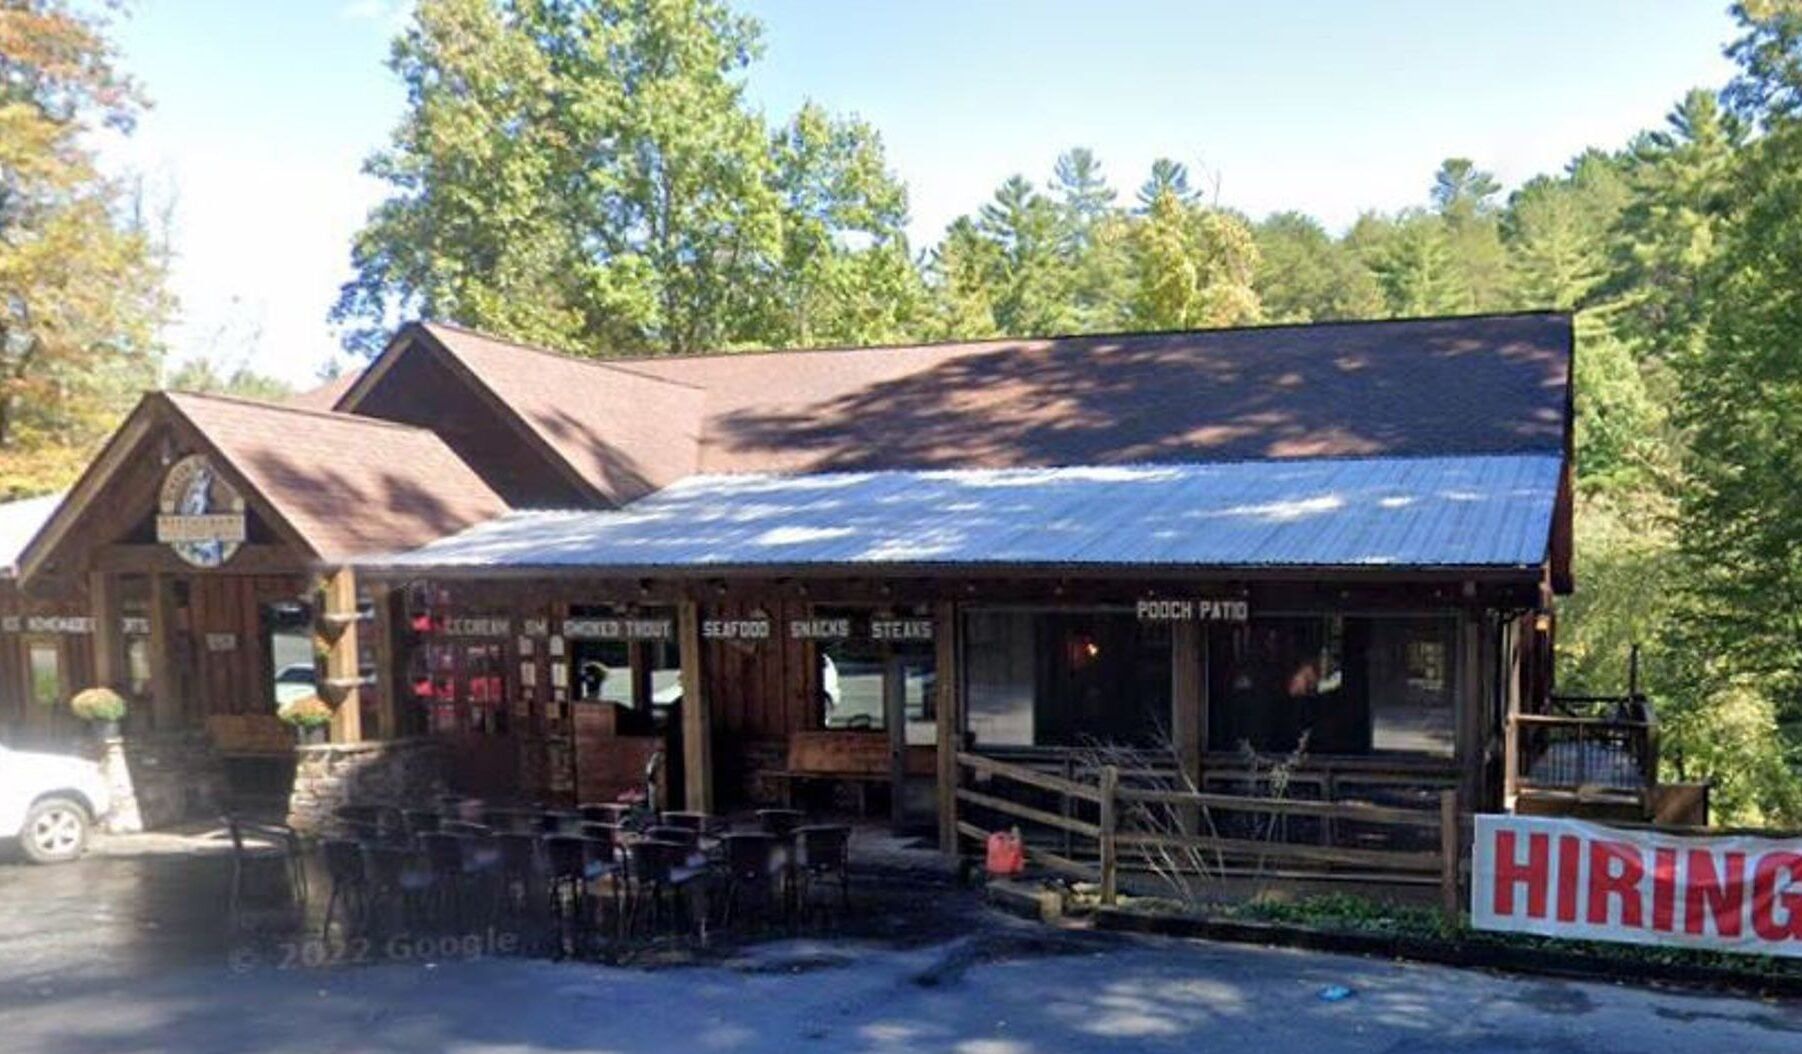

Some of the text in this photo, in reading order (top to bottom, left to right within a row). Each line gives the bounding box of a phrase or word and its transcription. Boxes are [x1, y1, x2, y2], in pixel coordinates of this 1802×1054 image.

[1137, 601, 1248, 620] POOCH PATIO
[624, 620, 671, 637] TROUT
[703, 620, 769, 638] SEAFOOD
[791, 620, 849, 638] SNACKS
[871, 621, 932, 638] STEAKS
[1493, 829, 1802, 942] HIRING
